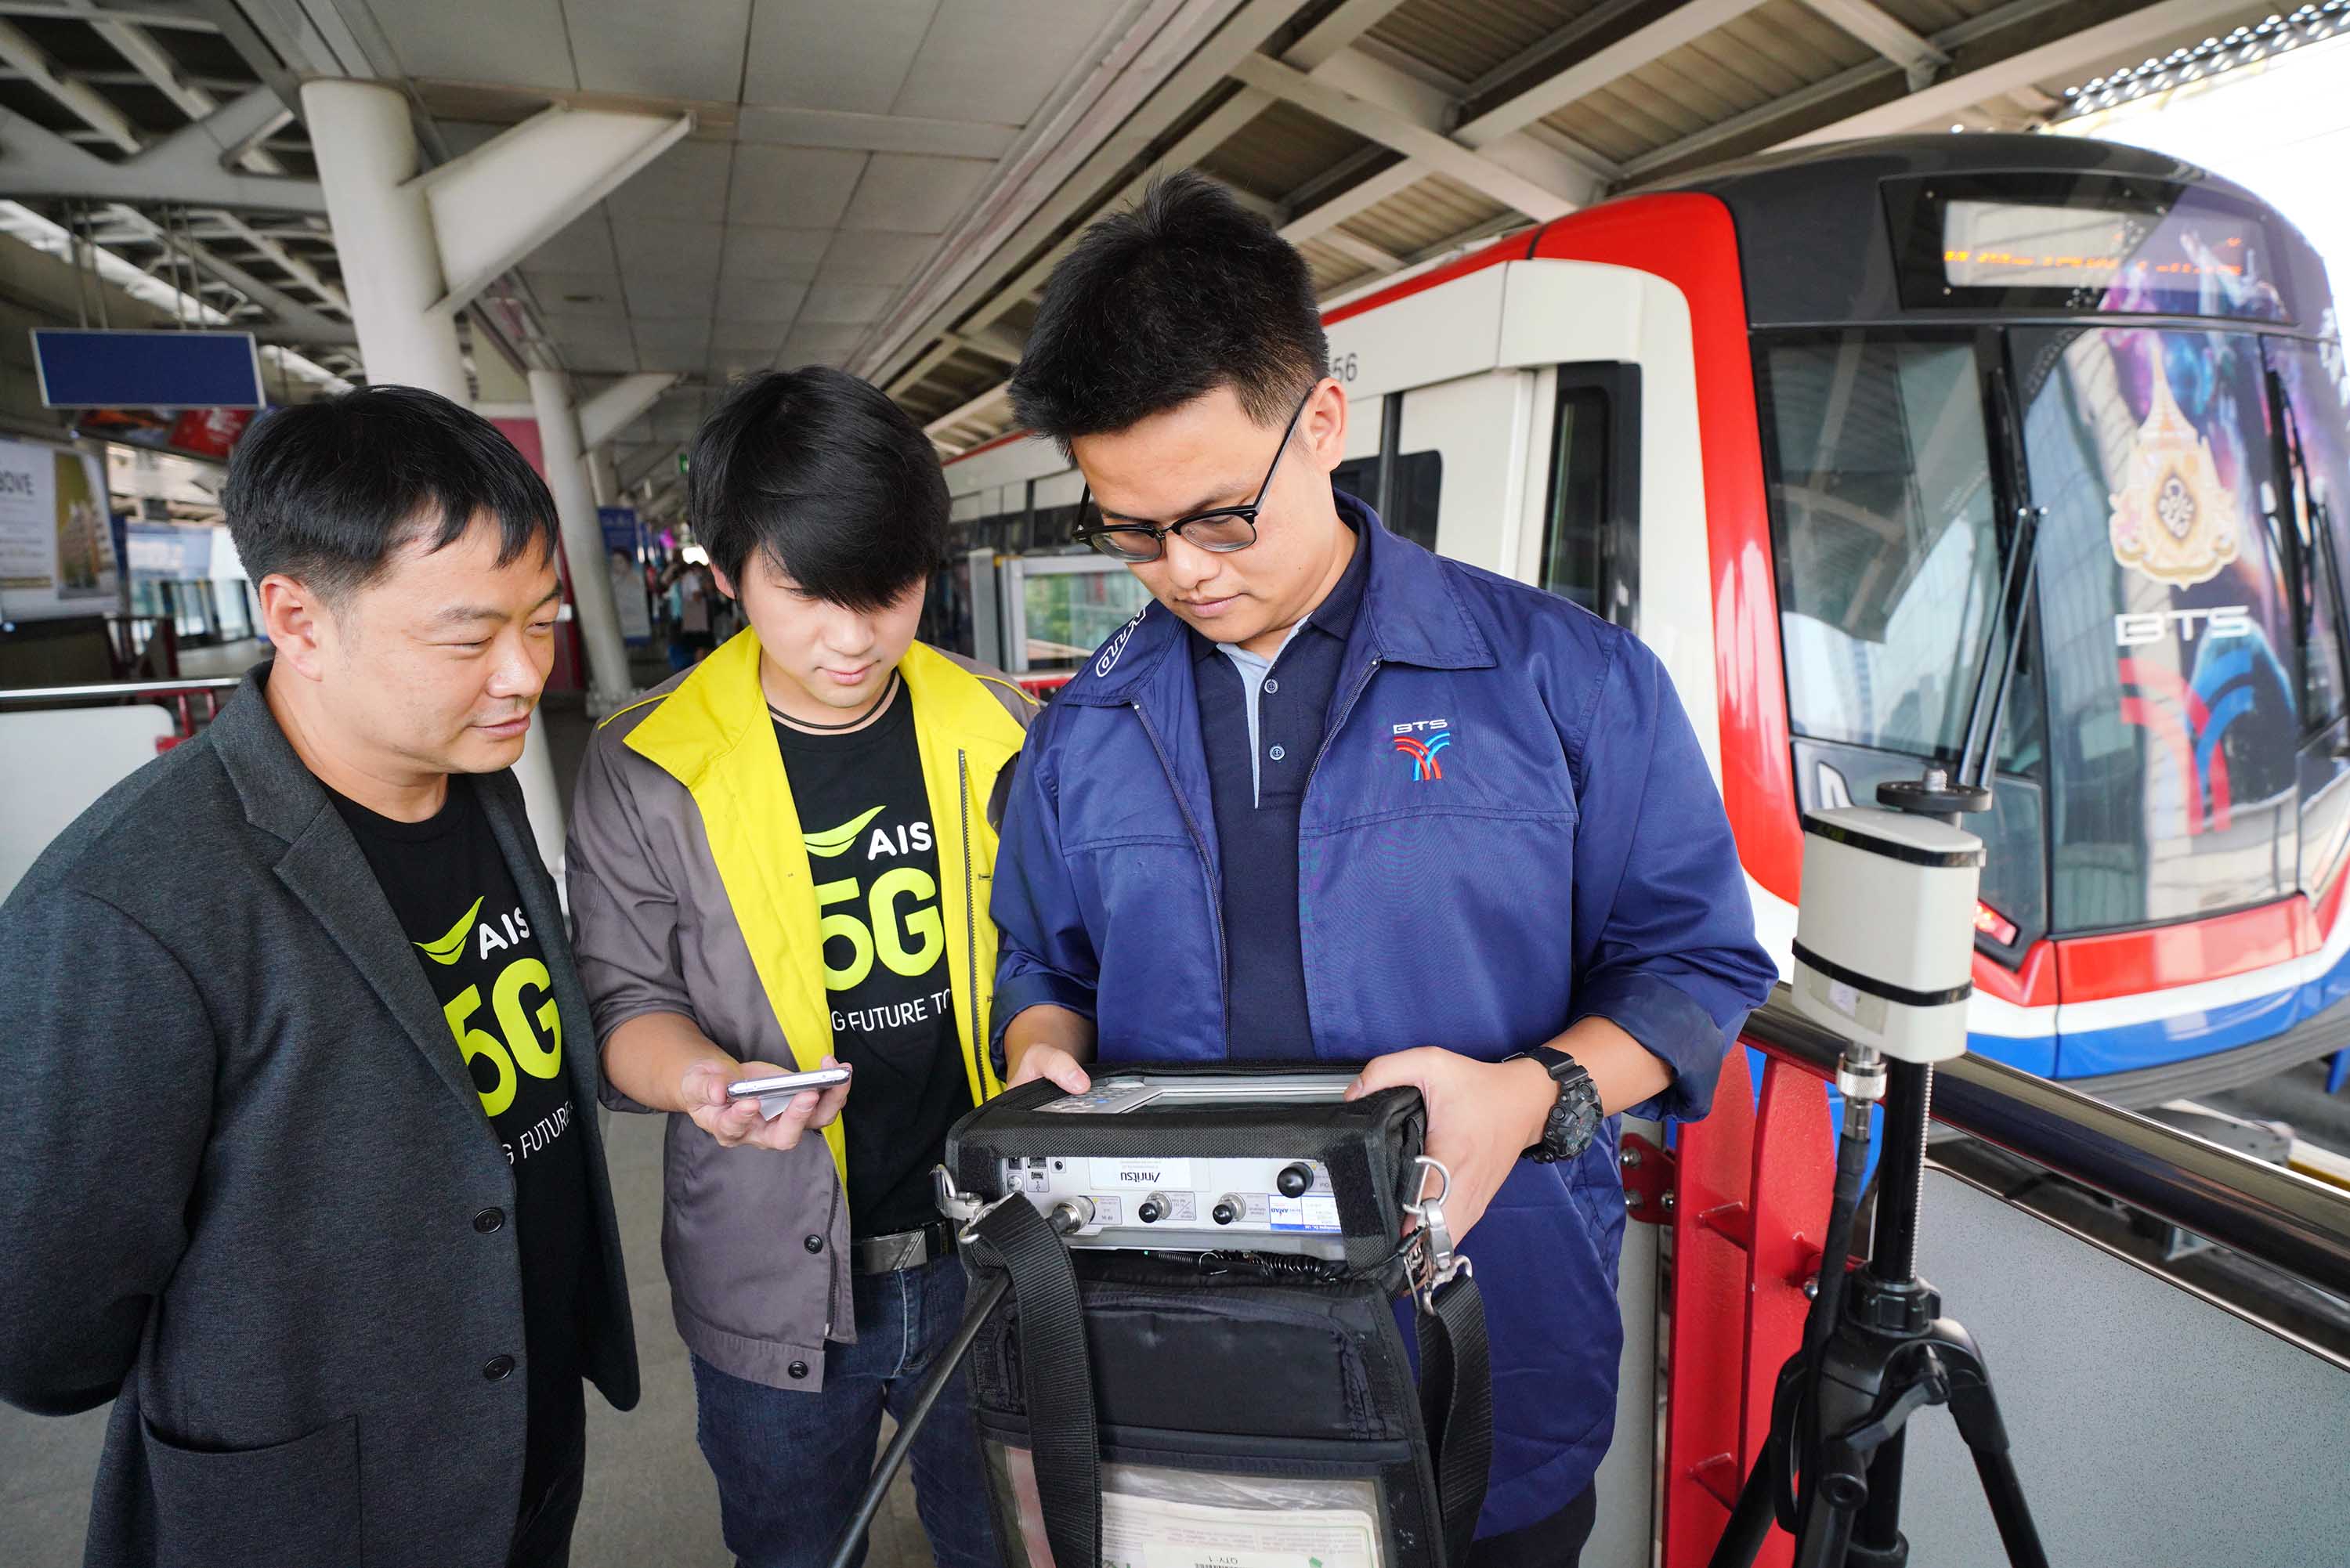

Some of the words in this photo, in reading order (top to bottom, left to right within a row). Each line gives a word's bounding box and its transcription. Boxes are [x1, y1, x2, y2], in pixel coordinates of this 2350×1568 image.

[2115, 605, 2250, 646] BTS
[1393, 719, 1448, 735] BTS
[867, 822, 932, 861] AIS
[479, 906, 530, 960] AIS
[814, 867, 945, 992] 5G
[848, 998, 928, 1031] FUTURE
[443, 957, 562, 1118] 5G
[520, 1101, 570, 1158] FUTURE
[1120, 1172, 1161, 1183] Anritsu
